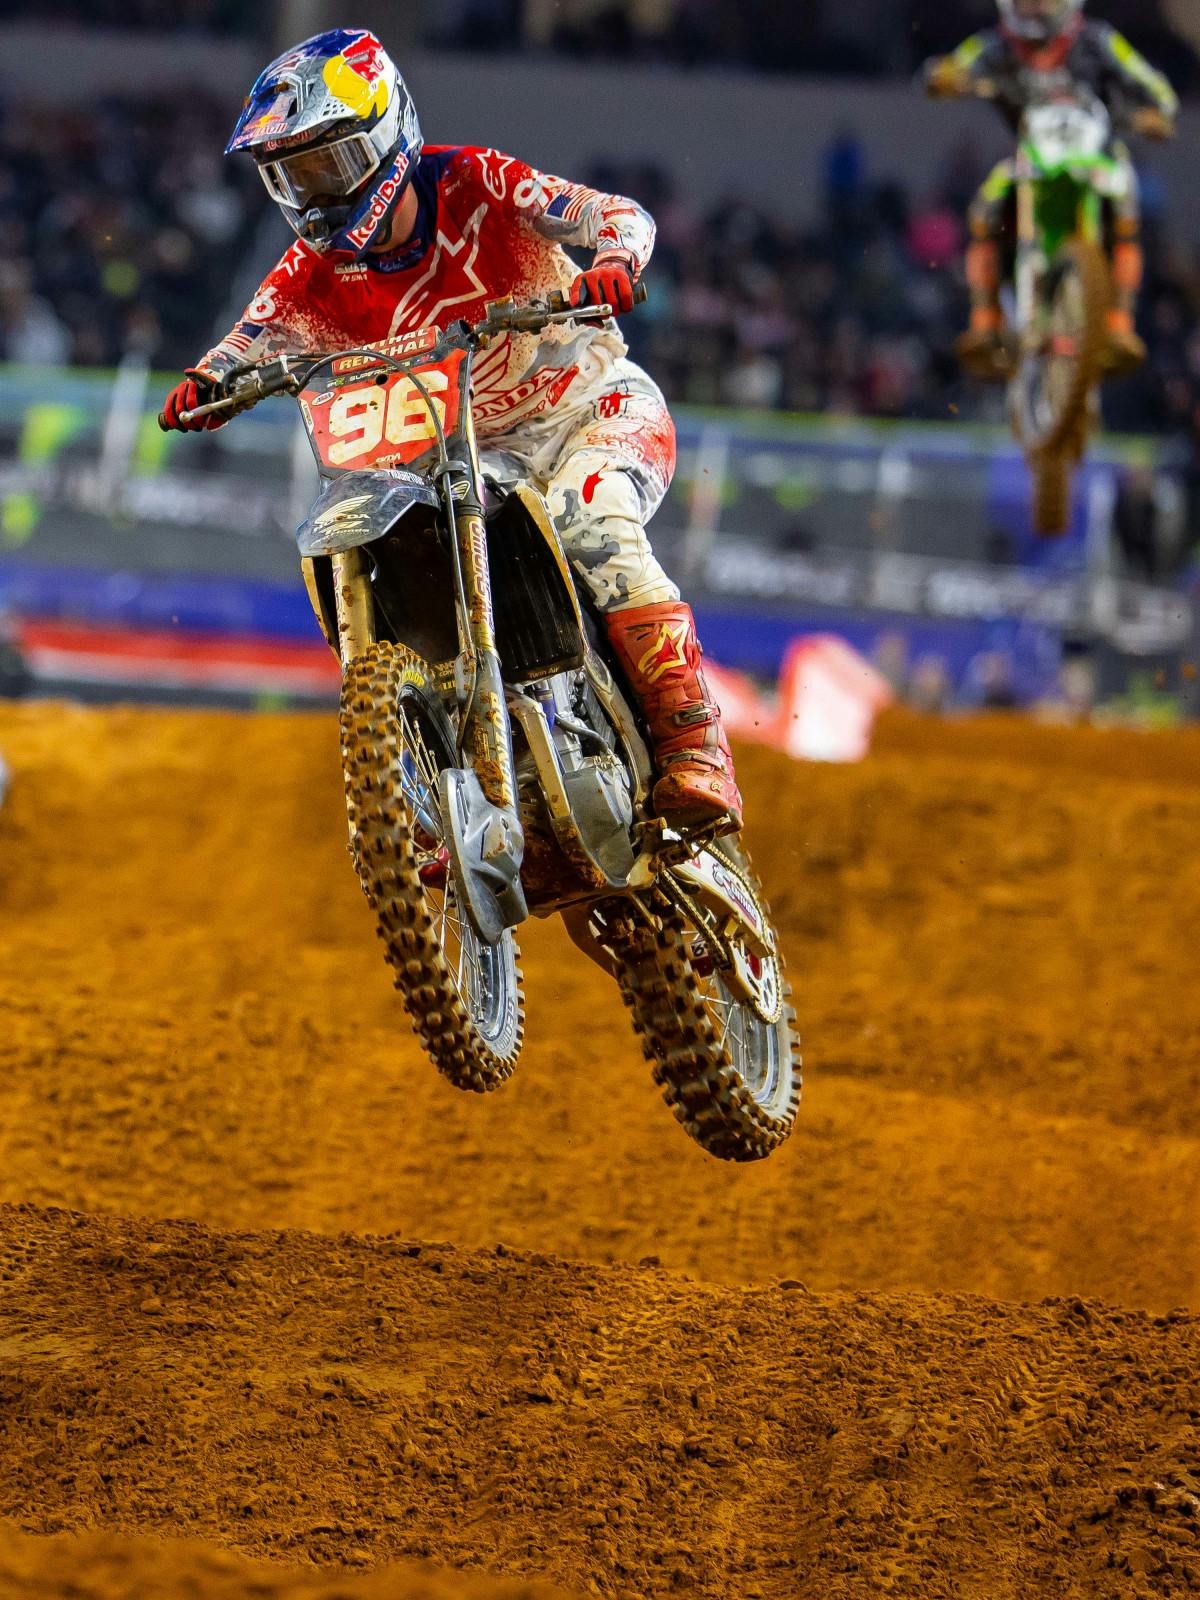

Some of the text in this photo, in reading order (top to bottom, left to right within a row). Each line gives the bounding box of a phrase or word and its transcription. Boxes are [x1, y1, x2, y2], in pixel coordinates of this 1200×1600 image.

[346, 194, 388, 249] Red
[377, 151, 409, 203] Bull
[328, 369, 455, 466] 96
